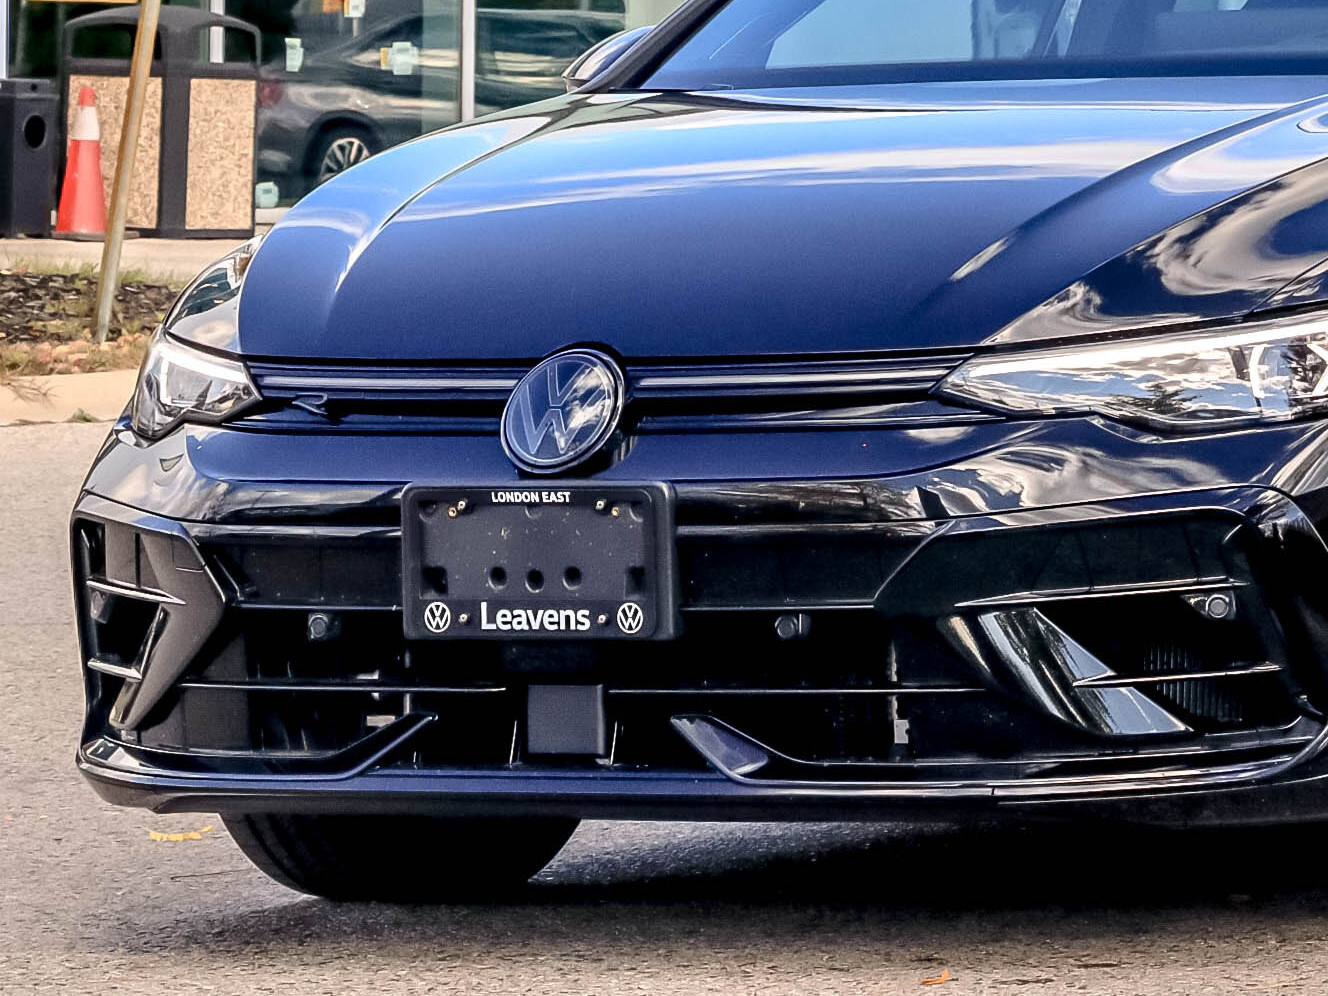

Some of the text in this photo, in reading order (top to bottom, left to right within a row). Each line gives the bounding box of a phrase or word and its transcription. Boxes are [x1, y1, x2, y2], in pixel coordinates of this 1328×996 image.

[506, 352, 621, 466] VW
[491, 491, 571, 503] LONDON EAST
[480, 601, 591, 632] Leavens
